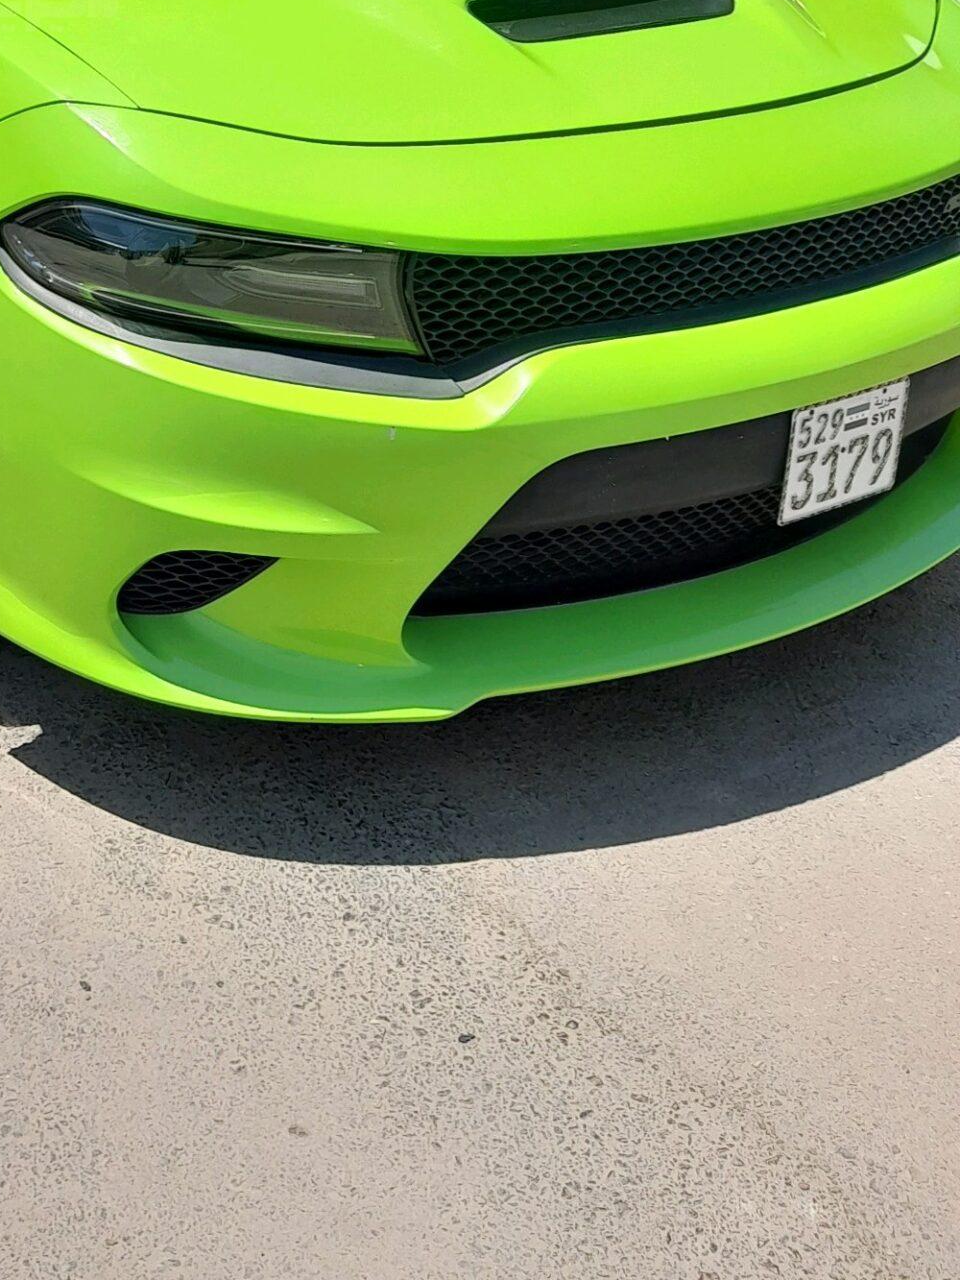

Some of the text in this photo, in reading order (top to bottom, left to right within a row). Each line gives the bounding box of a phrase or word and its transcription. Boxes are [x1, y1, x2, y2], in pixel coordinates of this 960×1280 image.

[797, 407, 844, 449] 529
[871, 407, 897, 426] SYR
[791, 428, 893, 511] 3179
